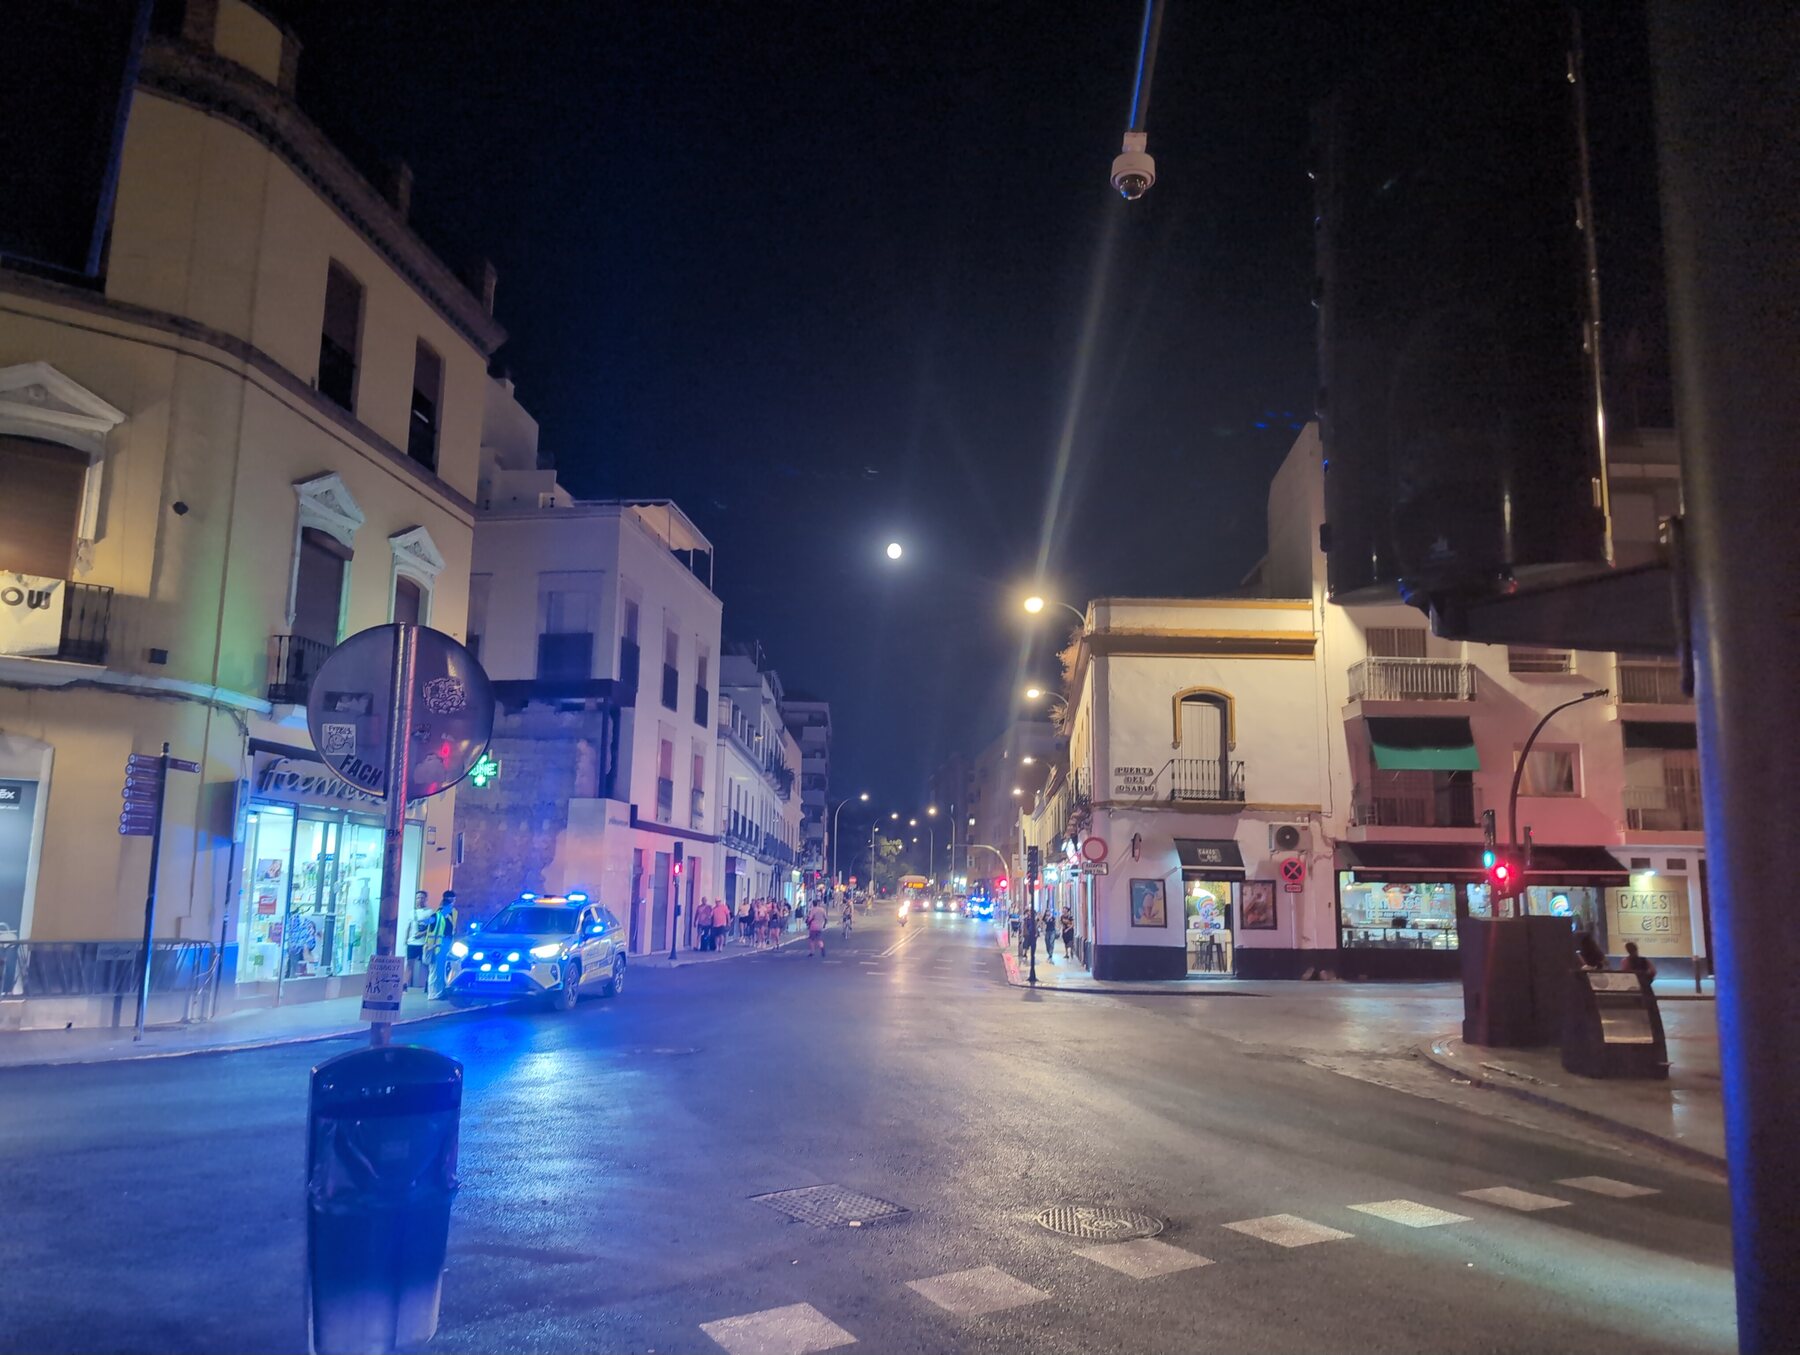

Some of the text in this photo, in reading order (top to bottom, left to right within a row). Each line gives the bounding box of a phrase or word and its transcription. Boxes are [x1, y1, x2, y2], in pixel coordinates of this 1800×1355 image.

[340, 754, 383, 786] FACH
[1116, 767, 1154, 775] PUERTA
[1117, 785, 1155, 793] OSARIO
[1620, 893, 1668, 910] CAKES
